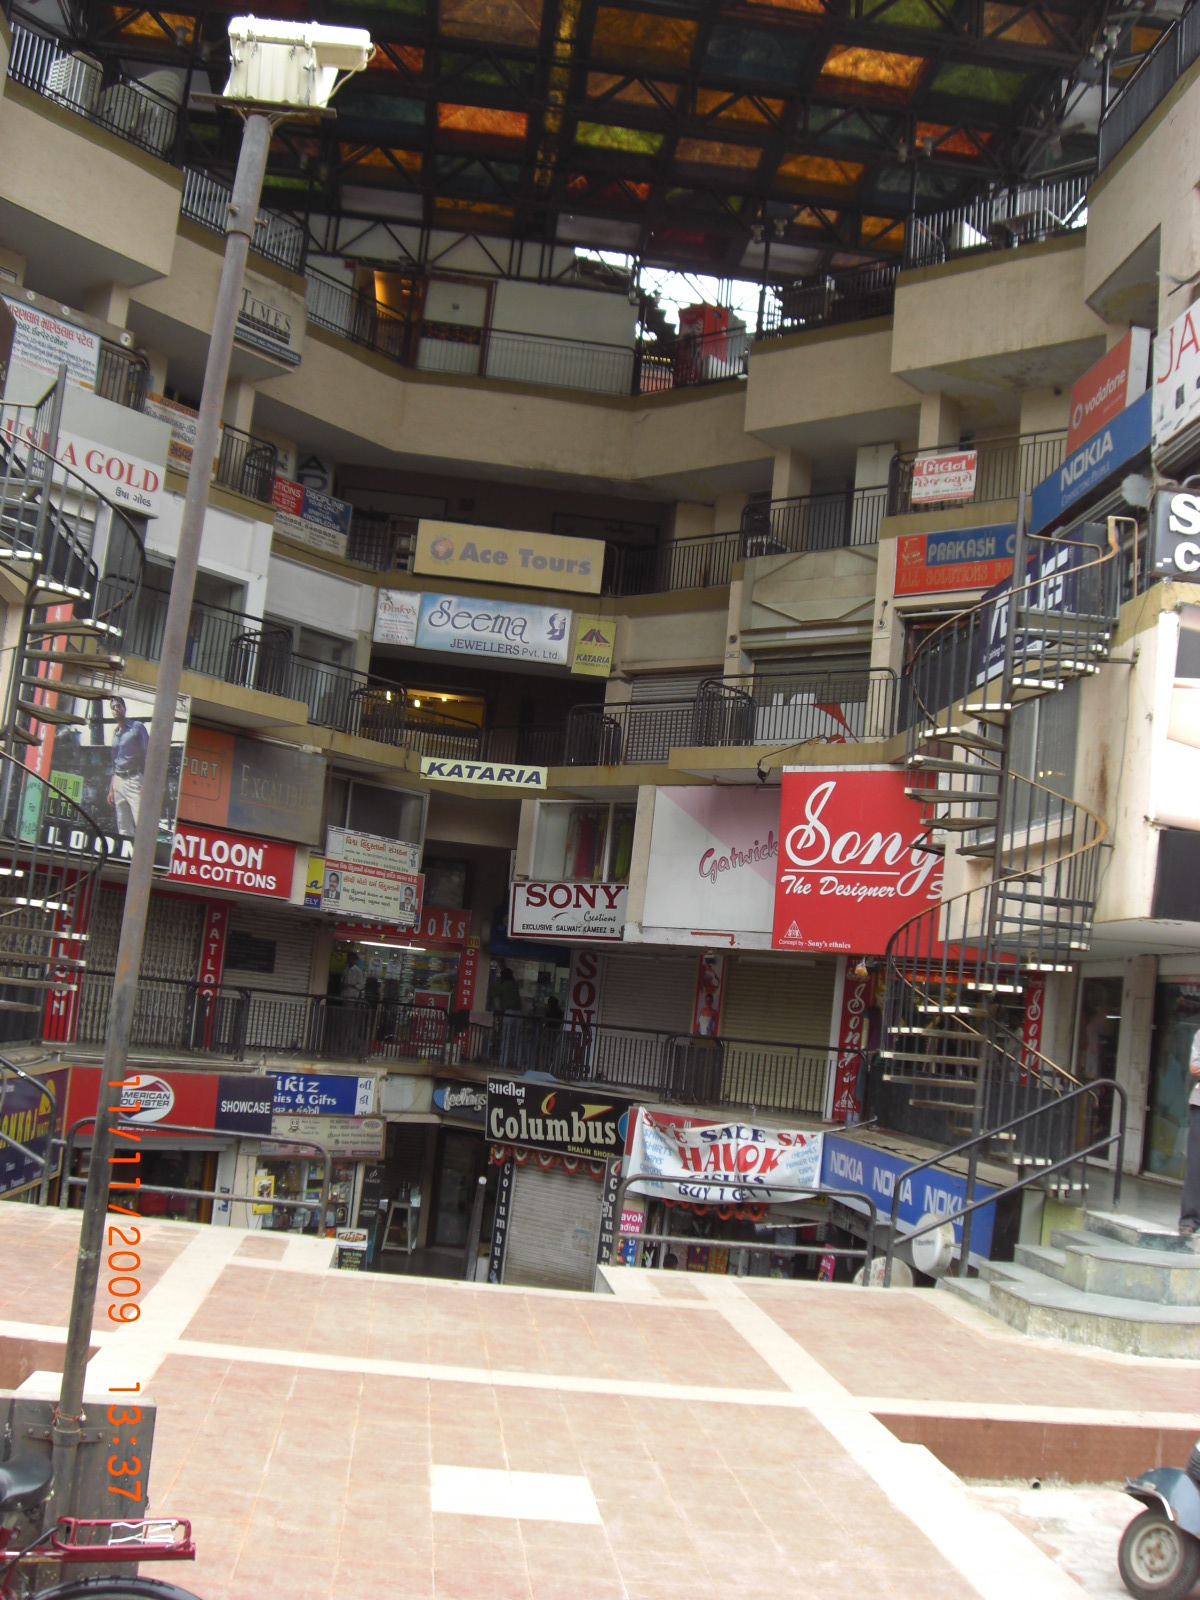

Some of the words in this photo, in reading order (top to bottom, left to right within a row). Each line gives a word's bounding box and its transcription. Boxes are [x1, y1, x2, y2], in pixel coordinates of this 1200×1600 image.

[241, 287, 292, 332] TIMES
[1085, 369, 1126, 416] vodafone
[84, 449, 159, 493] GOLD
[1060, 430, 1114, 492] NOKIA
[115, 486, 130, 500] ઉષા
[459, 541, 509, 566] Ace
[518, 547, 592, 576] Tours
[927, 536, 997, 563] PRAKASH
[380, 602, 417, 619] Pinky's
[428, 599, 529, 645] Seema
[450, 638, 520, 656] JEWELLERS
[522, 646, 541, 659] Pvt.
[543, 648, 560, 660] Ltd.
[575, 653, 611, 665] KATARIA
[426, 761, 542, 785] KATARIA
[172, 833, 264, 870] ATLOON
[698, 831, 780, 884] Gatwick
[189, 864, 197, 875] &
[199, 864, 277, 890] COTTONS
[781, 875, 812, 895] The
[819, 875, 896, 903] Designer
[525, 883, 625, 909] SONY
[521, 923, 553, 932] EXCLUSIVE
[582, 926, 607, 934] KAMEEZ
[807, 940, 828, 948] Sony's
[275, 1075, 320, 1093] ikiz
[488, 1082, 526, 1098] શાલીન
[120, 1098, 170, 1107] OURISTER
[220, 1100, 271, 1114] SHOWCASE
[295, 1094, 305, 1104] &
[442, 1086, 488, 1112] feelings
[490, 1107, 617, 1145] Columbus
[700, 1125, 766, 1144] SALE
[567, 1144, 591, 1155] SHALIN
[678, 1142, 787, 1174] HAVOK
[678, 1182, 712, 1201] BUY
[830, 1150, 864, 1186] NOKIA
[924, 1184, 966, 1227] NOKI
[493, 1162, 511, 1269] Columbus
[601, 1177, 618, 1265] Columb
[619, 1222, 641, 1233] adies
[620, 1212, 643, 1223] avok
